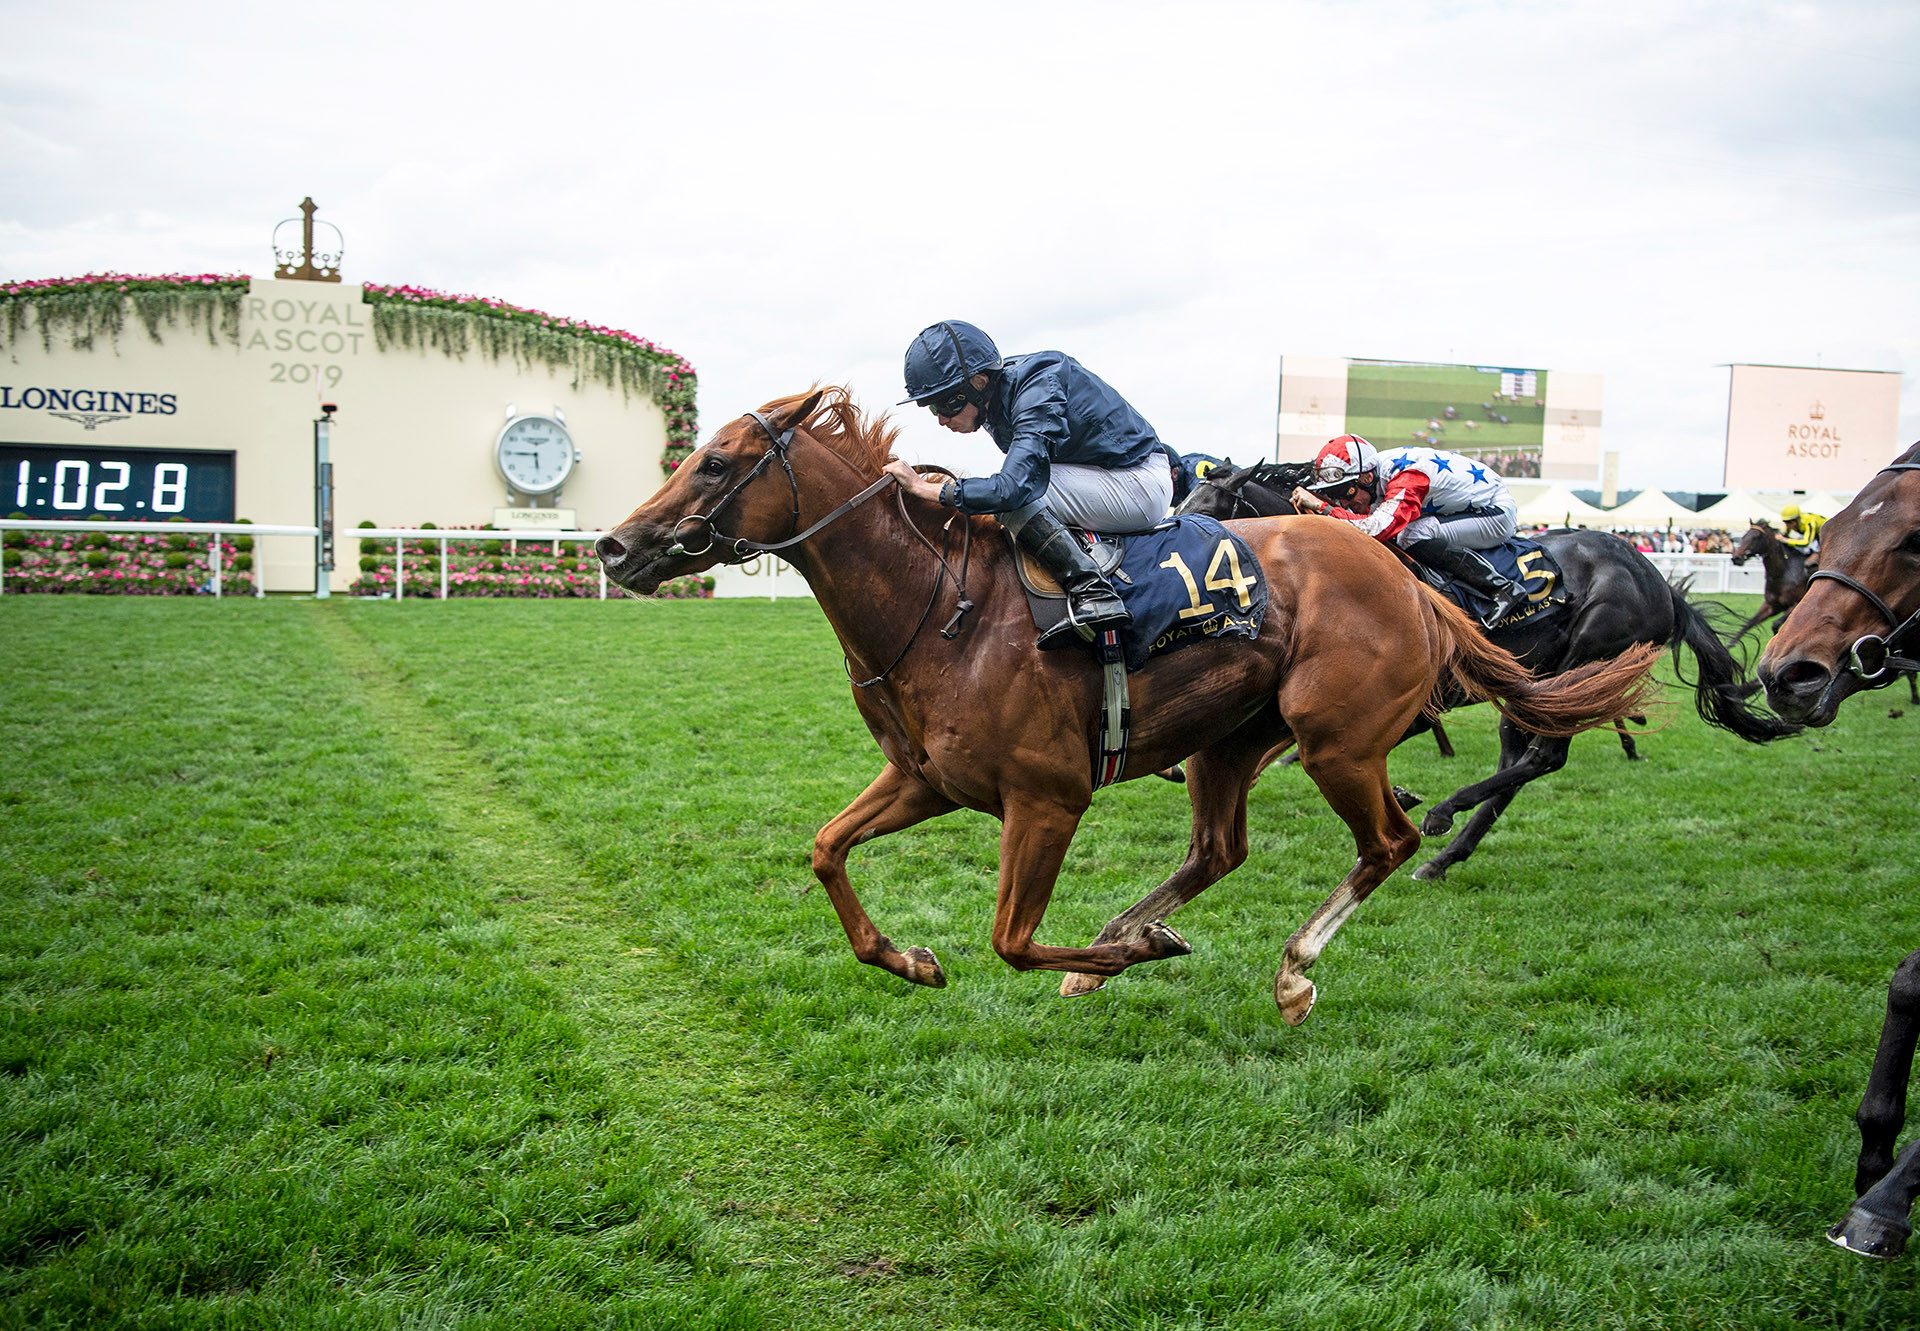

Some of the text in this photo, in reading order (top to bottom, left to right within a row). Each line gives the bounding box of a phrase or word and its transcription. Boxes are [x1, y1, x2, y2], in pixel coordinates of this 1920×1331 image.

[248, 298, 364, 327] ROYAL
[246, 328, 365, 355] ASCOT
[0, 386, 177, 415] LONGINES
[1788, 424, 1841, 441] ROYAL
[1787, 442, 1841, 459] ASCOT
[17, 459, 189, 513] 1:02.8
[1159, 538, 1257, 619] 14
[1517, 550, 1556, 602] 5
